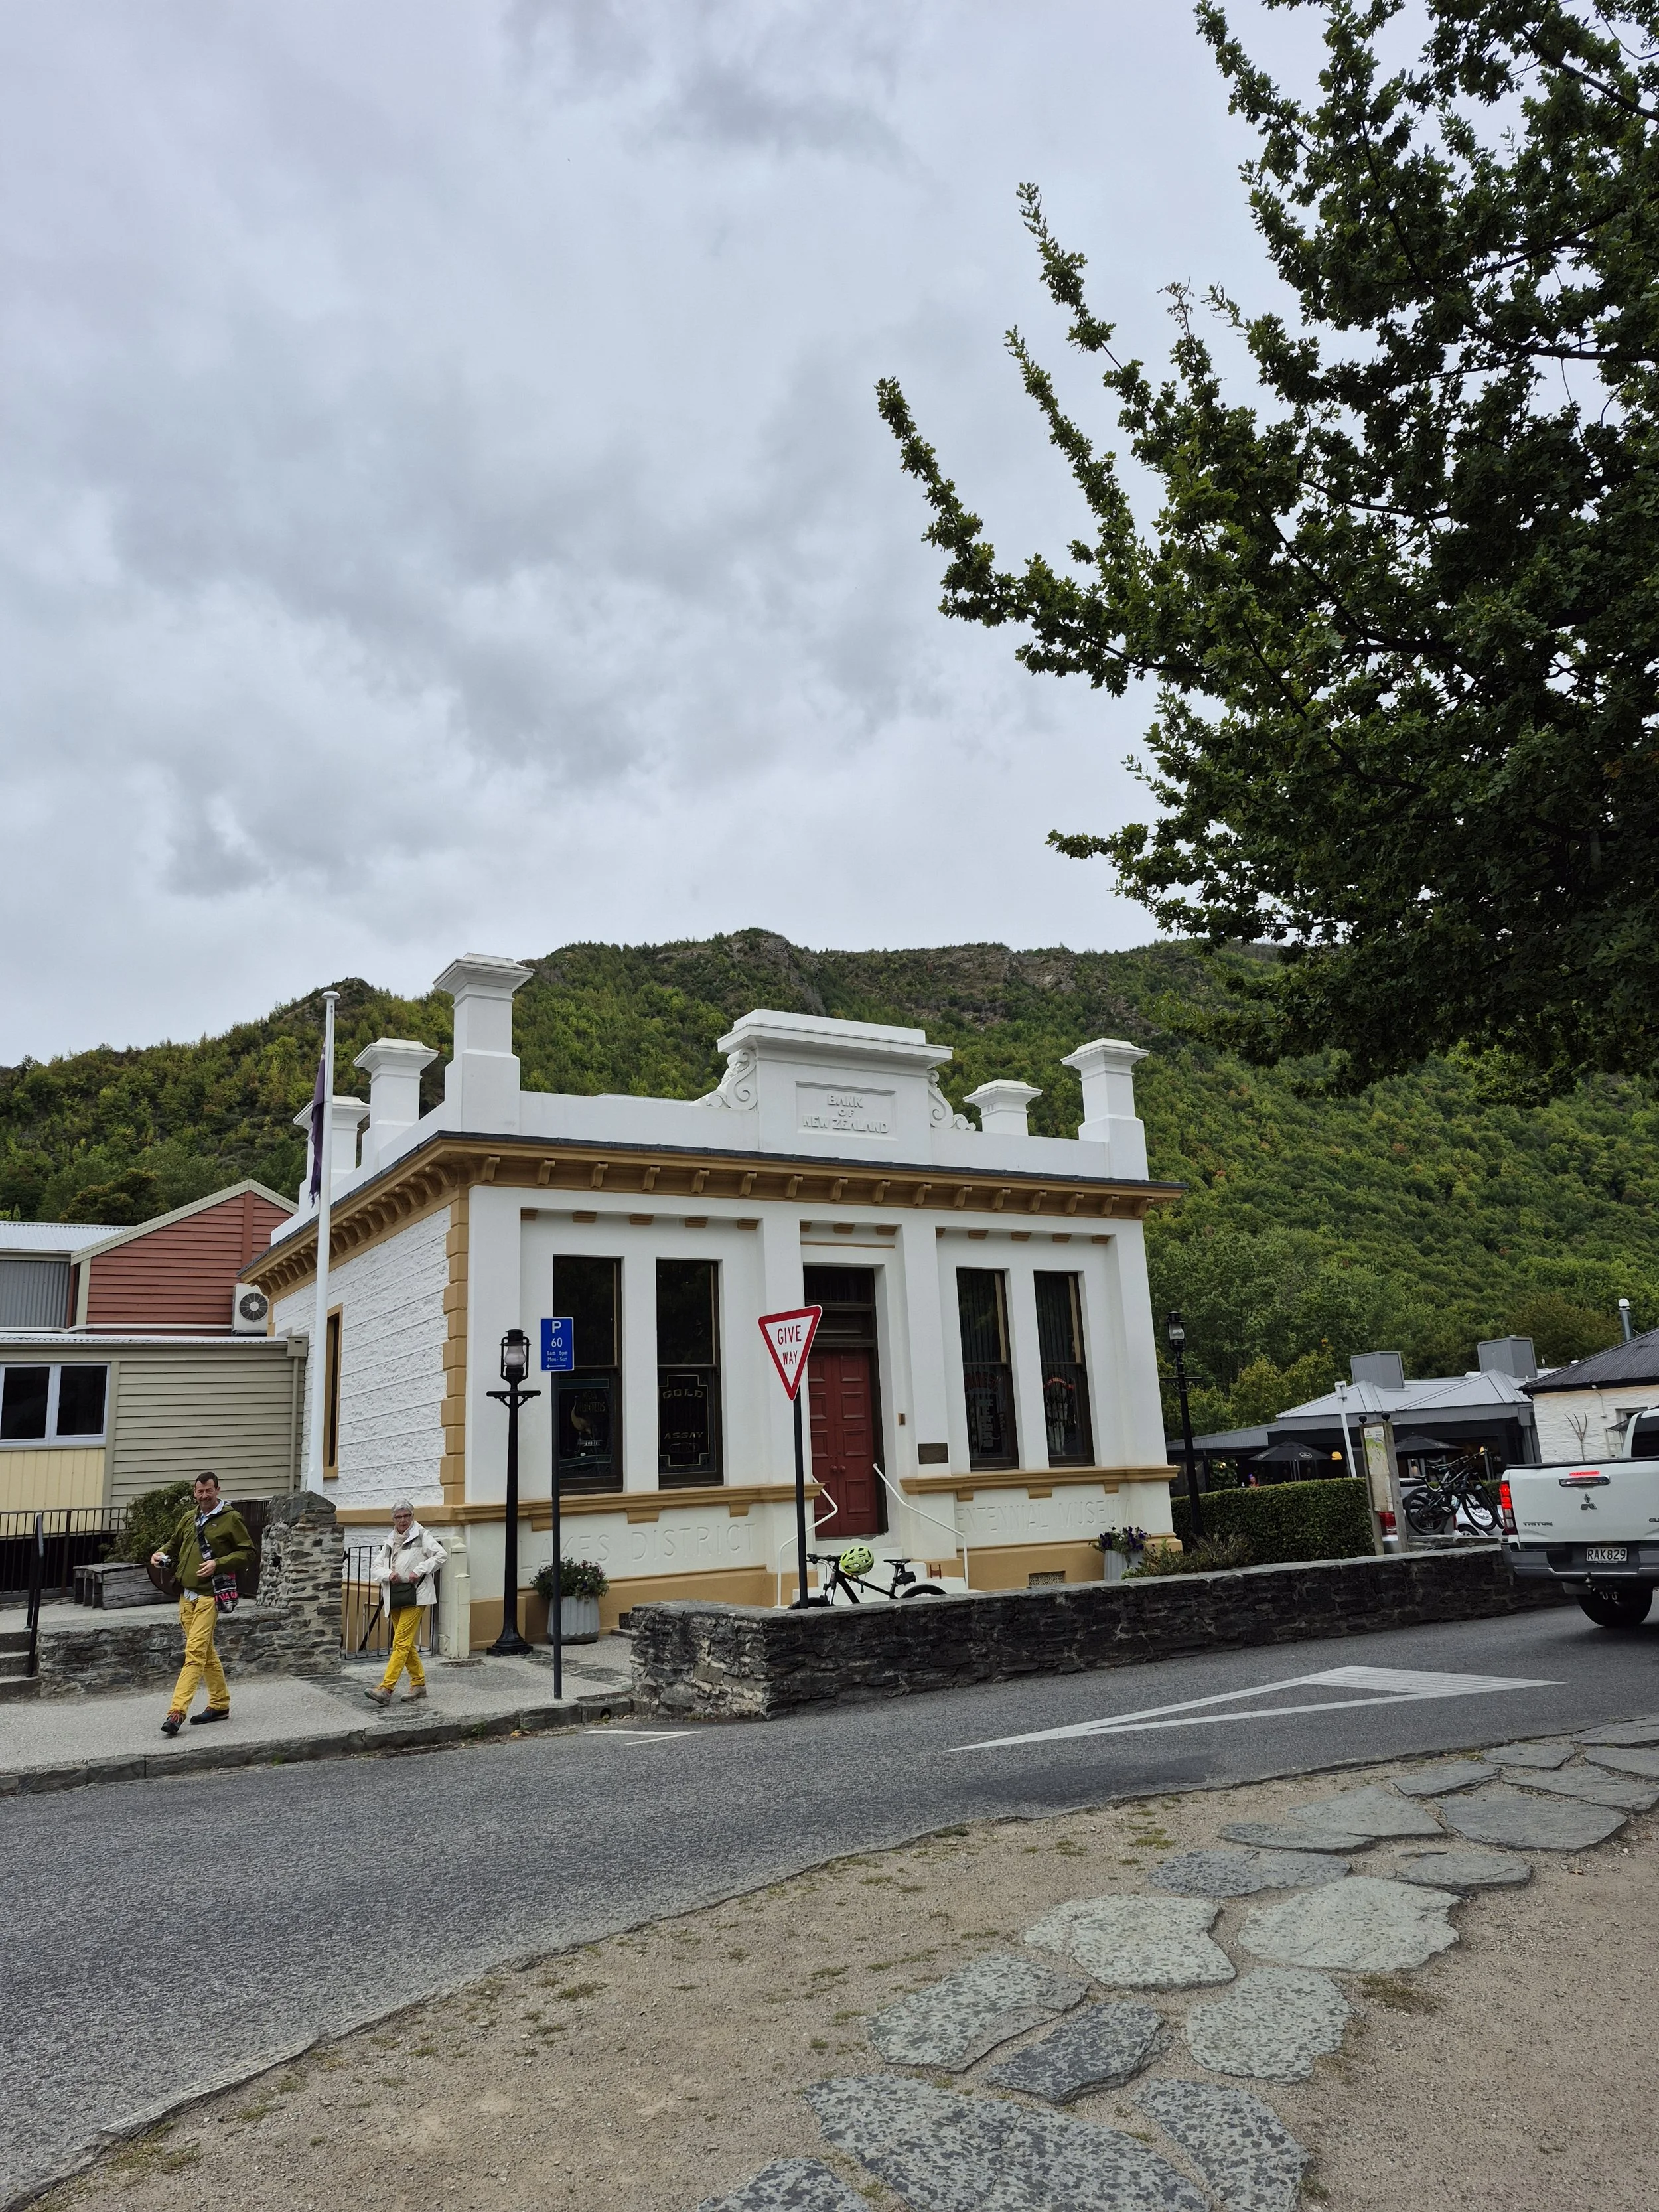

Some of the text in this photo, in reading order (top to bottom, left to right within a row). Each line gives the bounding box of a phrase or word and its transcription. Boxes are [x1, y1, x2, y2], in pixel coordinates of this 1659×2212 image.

[828, 1094, 864, 1108] BANK
[838, 1109, 855, 1118] OF
[802, 1115, 889, 1133] NEW ZEALAND
[552, 1321, 562, 1334] P
[551, 1337, 563, 1347] 60
[777, 1325, 802, 1345] GIVE
[782, 1350, 798, 1365] WAY
[662, 1388, 704, 1399] GOLD
[956, 1499, 1133, 1534] ENTENNIAL MUSEUM
[631, 1523, 757, 1563] DISTRICT
[1588, 1549, 1626, 1560] RAK829
